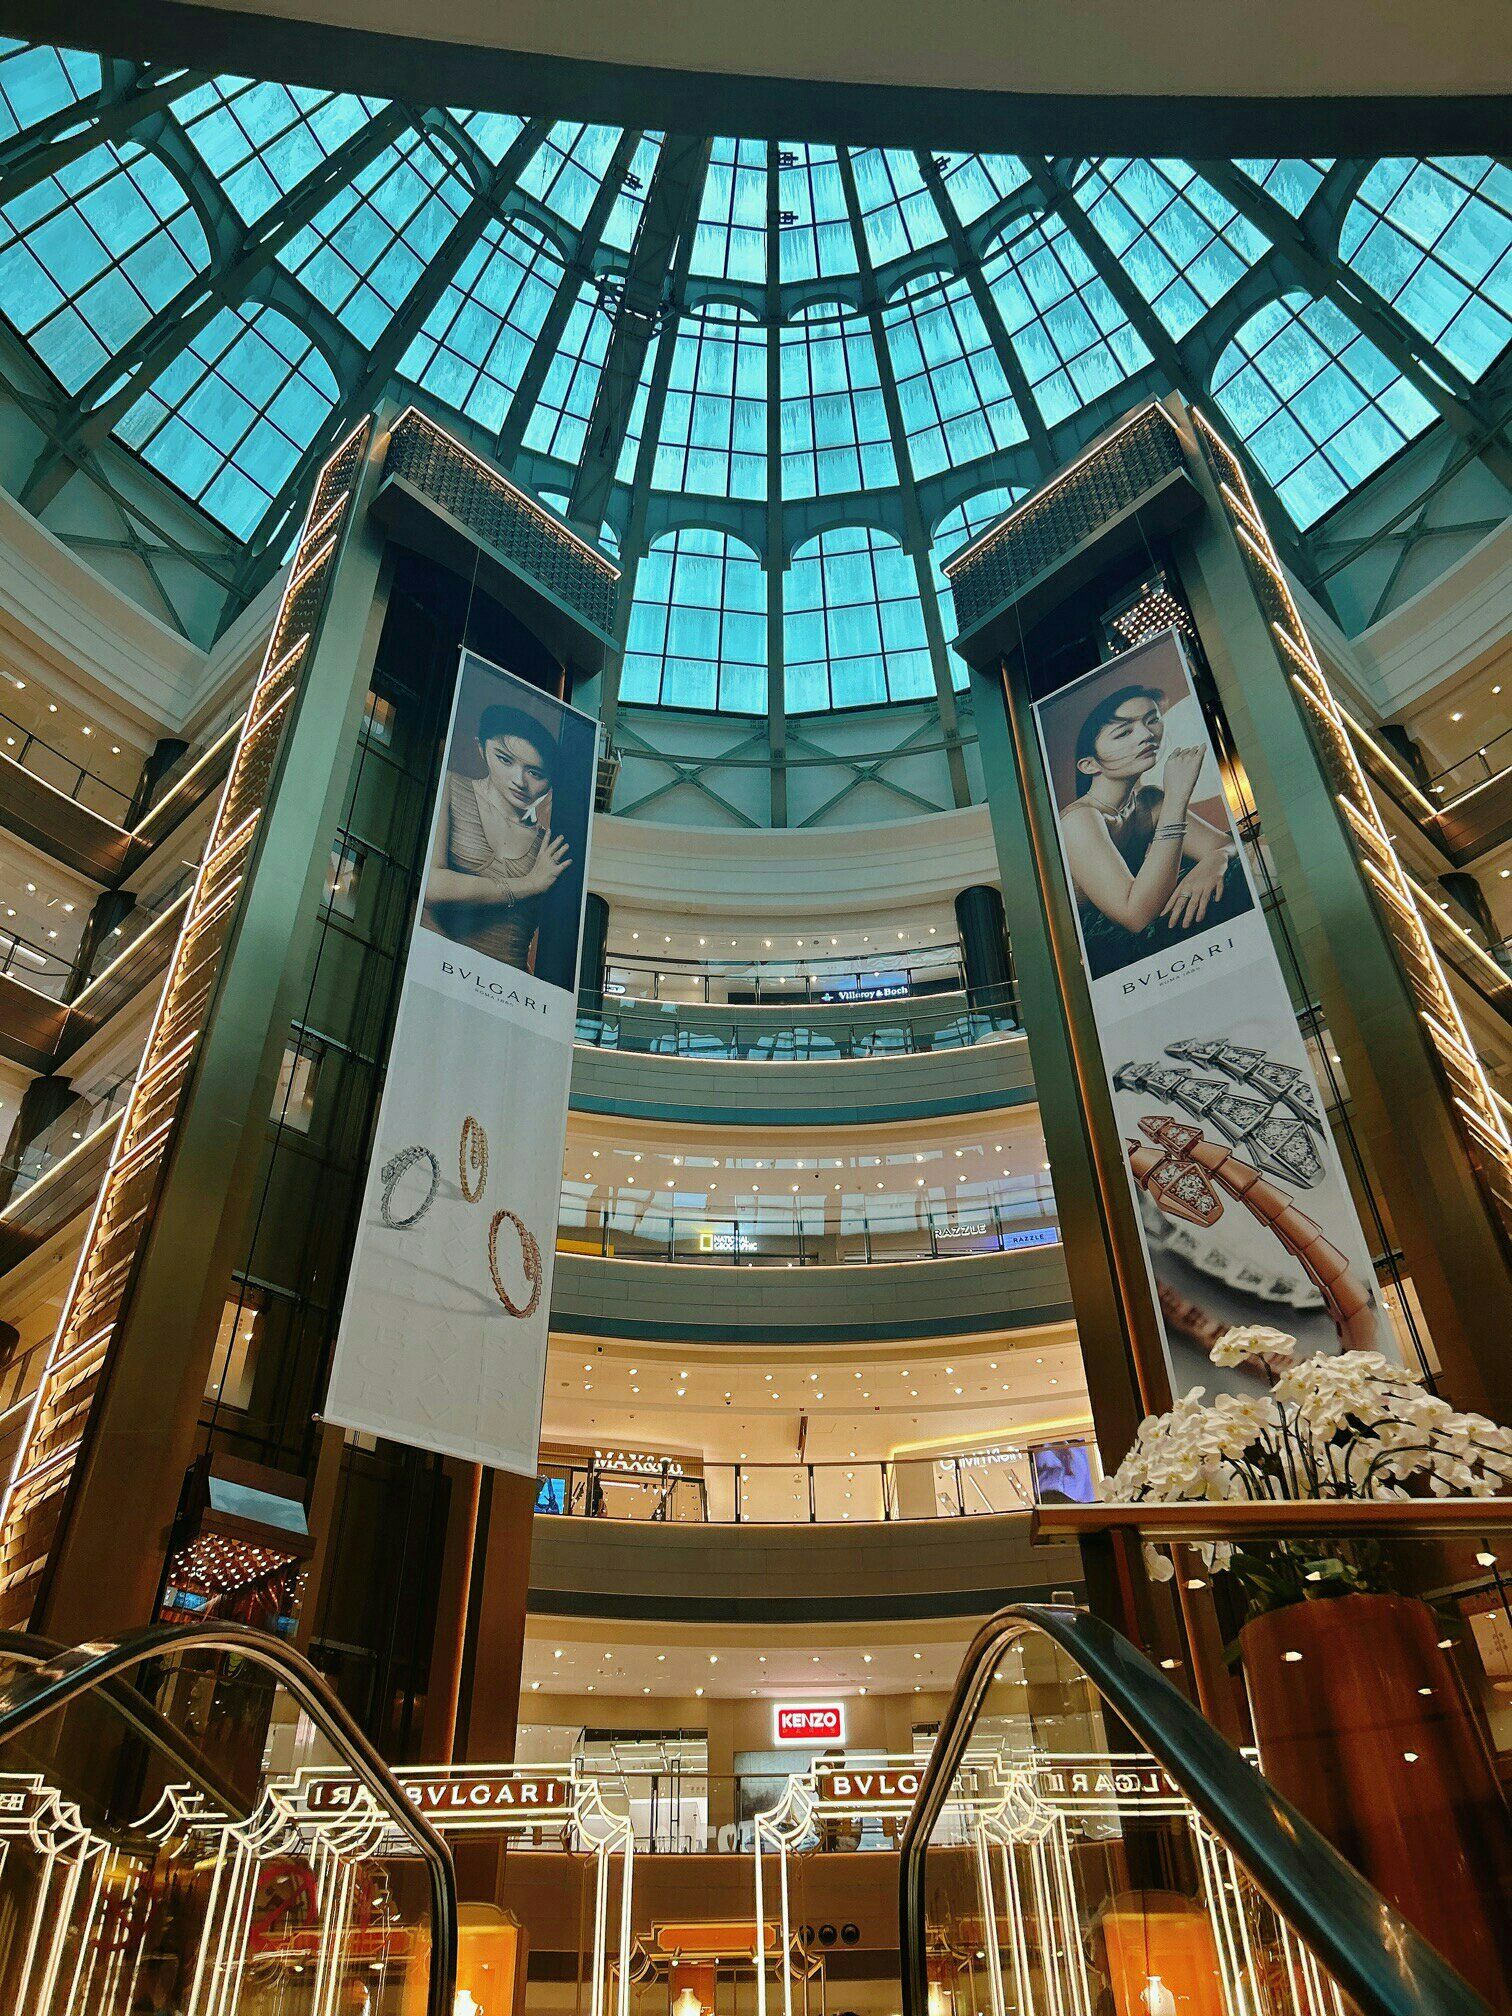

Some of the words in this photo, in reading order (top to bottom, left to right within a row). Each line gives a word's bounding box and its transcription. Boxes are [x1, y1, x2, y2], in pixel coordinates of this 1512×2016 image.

[1122, 938, 1234, 994] BVLGARI
[441, 961, 548, 1014] BVLGARI
[838, 991, 876, 1000] Villeroy
[884, 986, 909, 996] Boch
[934, 1224, 987, 1239] RAZZLE
[1013, 1233, 1045, 1243] RAZZLE
[782, 1712, 837, 1728] KENZO
[406, 1783, 555, 1805] BVLGARI
